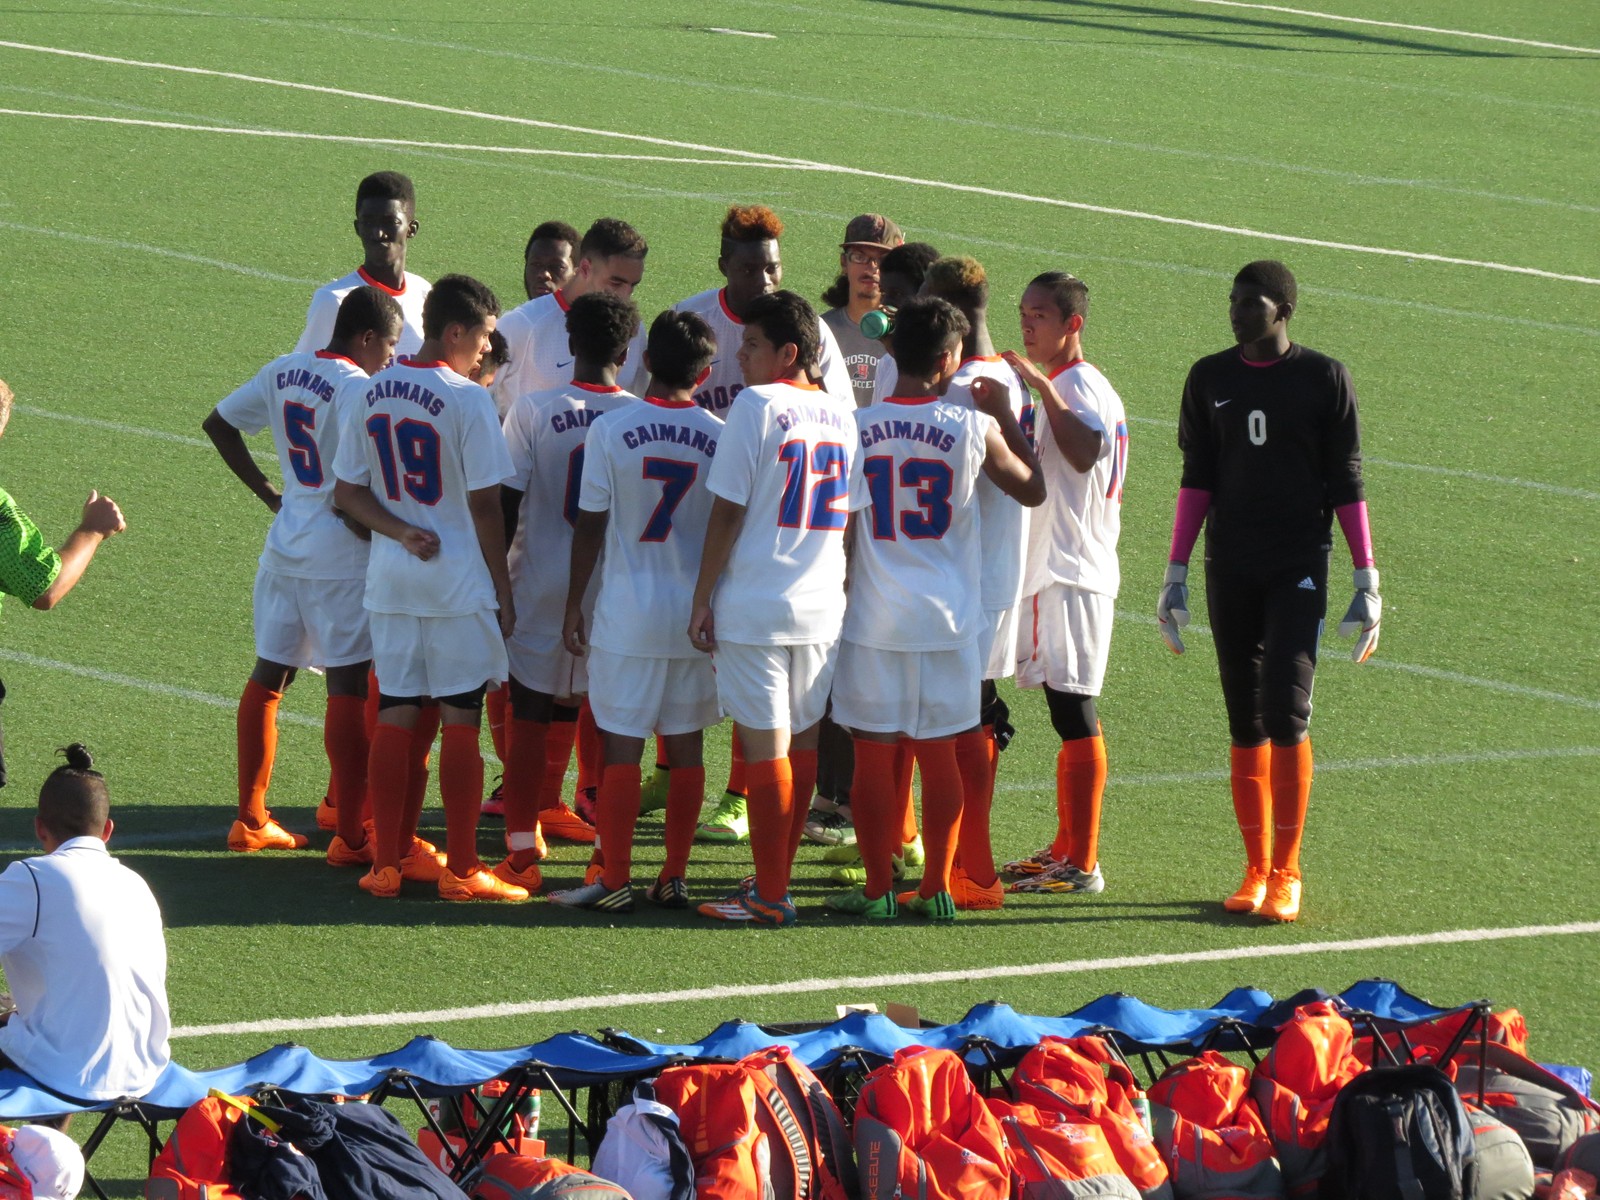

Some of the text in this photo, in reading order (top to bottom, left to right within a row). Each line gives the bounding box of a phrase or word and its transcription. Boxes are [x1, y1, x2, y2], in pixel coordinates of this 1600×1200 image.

[843, 354, 881, 366] HOSTO
[276, 369, 335, 403] CAIMANS
[366, 380, 445, 417] CAIMANS
[692, 383, 744, 410] HOS
[851, 379, 876, 389] OCCE
[551, 408, 604, 433] CAIM
[860, 420, 956, 452] CAIMANS
[1248, 410, 1267, 446] 0
[283, 400, 324, 488] 5
[622, 423, 718, 458] CAIMANS
[366, 413, 443, 506] 19
[639, 456, 698, 542] 7
[777, 439, 849, 531] 12
[863, 455, 954, 541] 13
